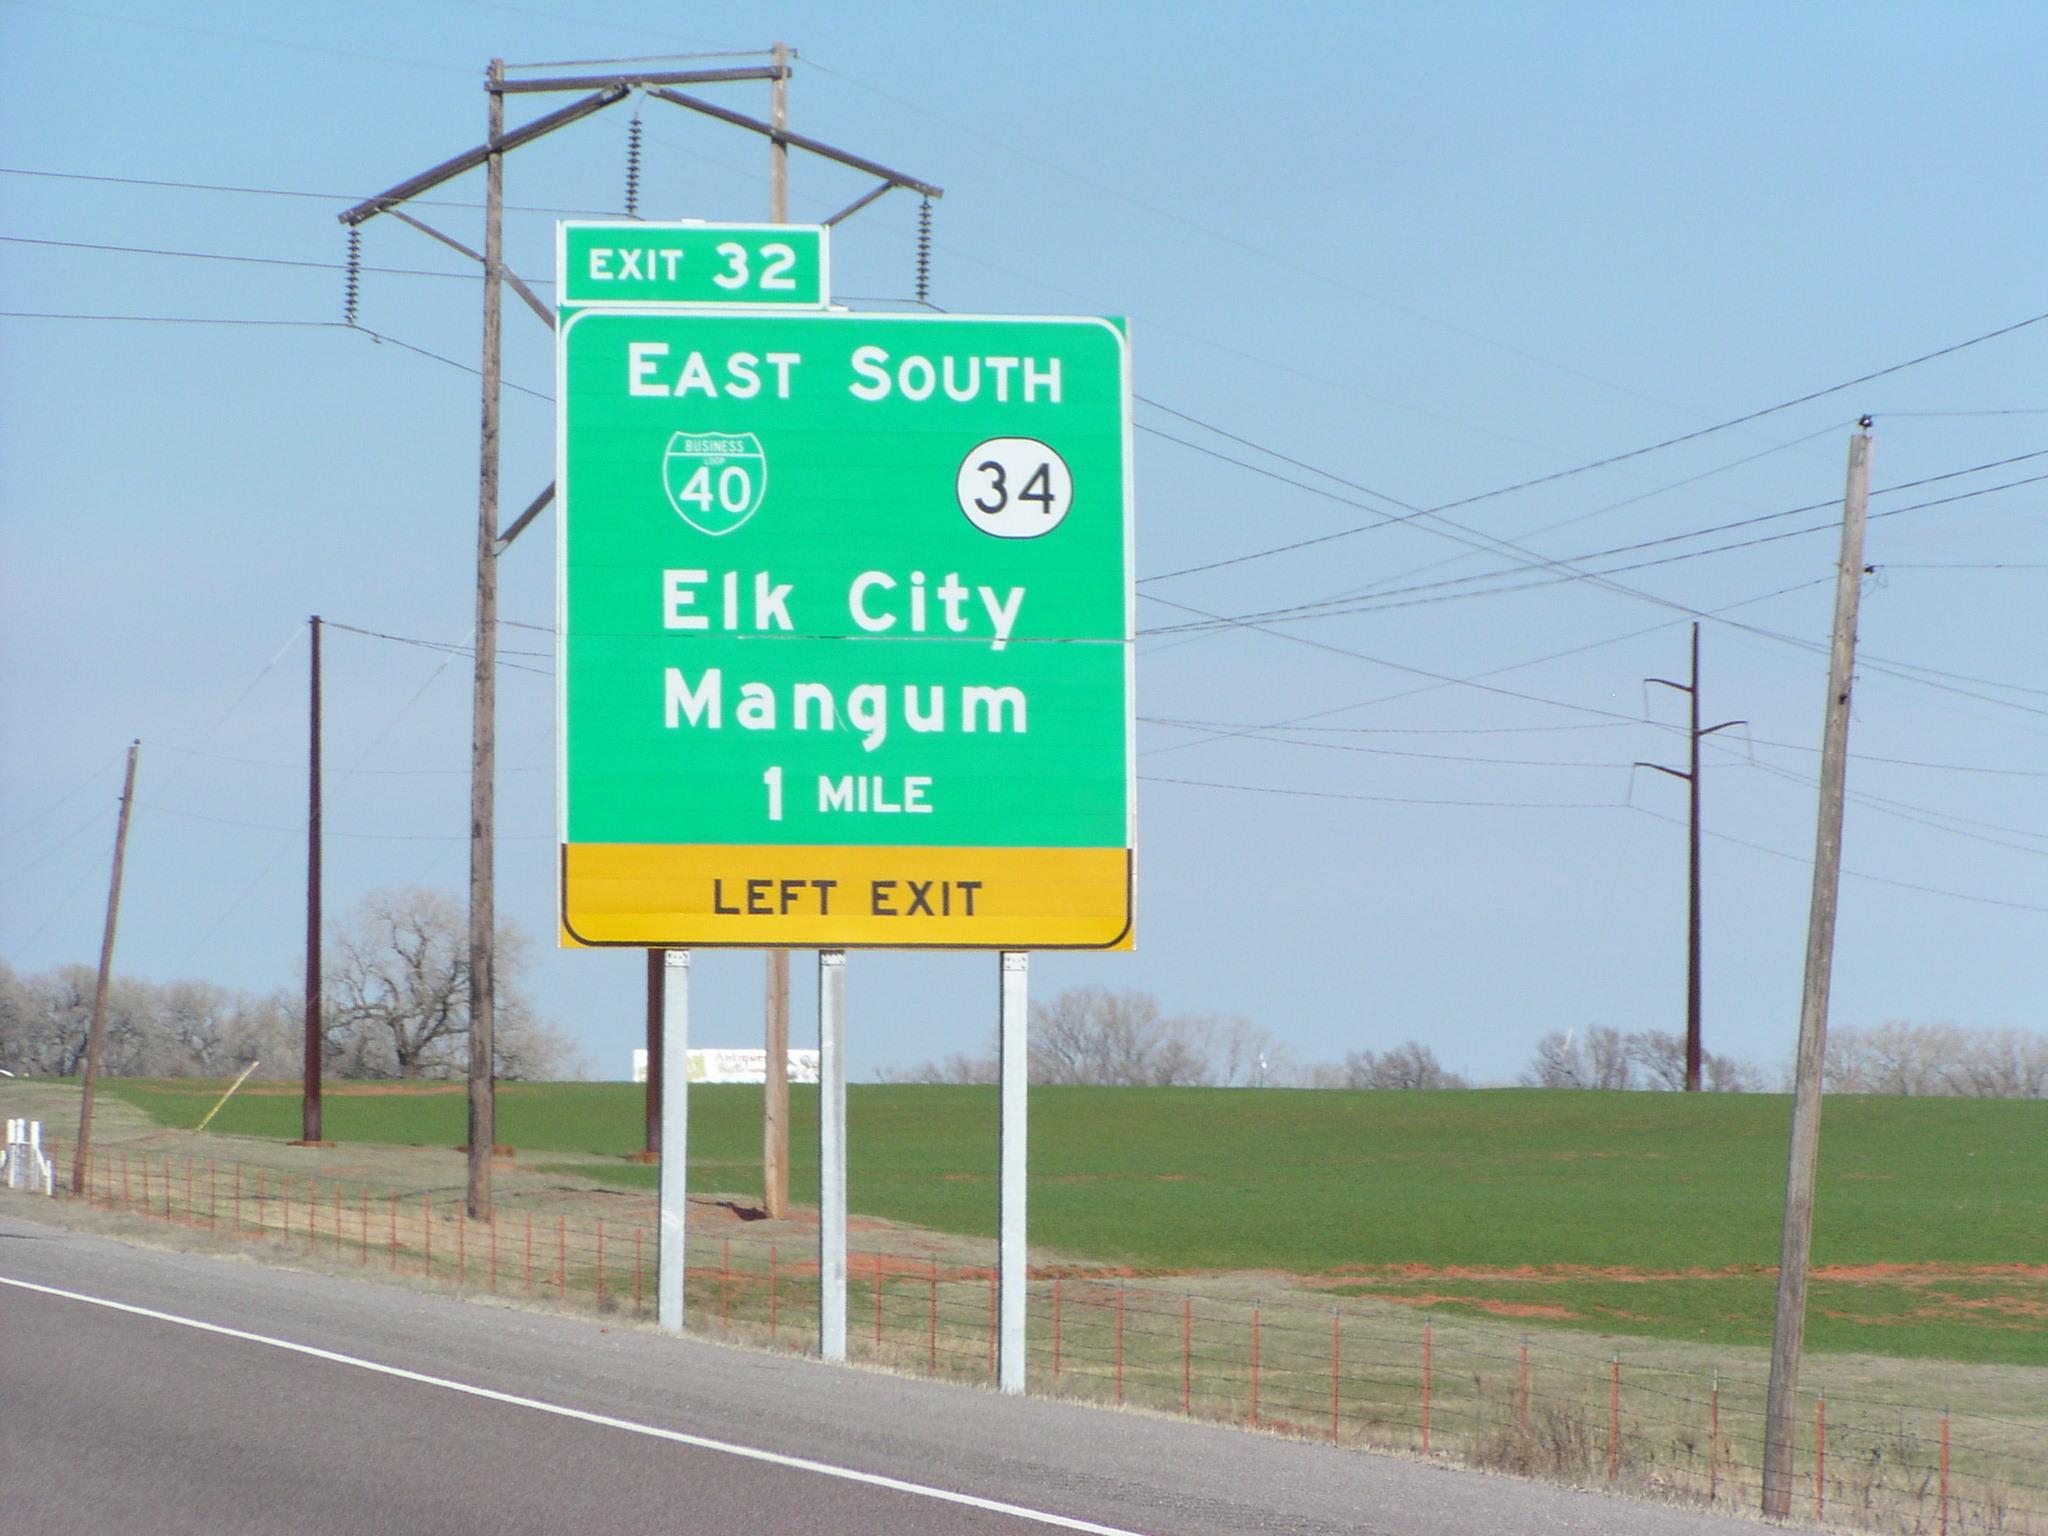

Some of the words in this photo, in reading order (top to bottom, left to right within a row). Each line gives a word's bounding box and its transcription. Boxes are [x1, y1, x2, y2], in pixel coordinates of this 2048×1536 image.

[589, 248, 683, 281] EXIT
[713, 241, 796, 290] 32
[628, 342, 801, 399] EAST
[849, 346, 1062, 404] SOUTH
[684, 439, 745, 452] BUSINESS
[680, 466, 751, 512] 40
[975, 461, 1055, 514] 34
[663, 569, 794, 631] Elk
[849, 571, 1026, 651] City
[665, 668, 1027, 753] Mangum
[764, 766, 783, 821] 1
[819, 775, 934, 814] MILE
[714, 880, 837, 915] LEFT
[873, 881, 982, 916] EXIT
